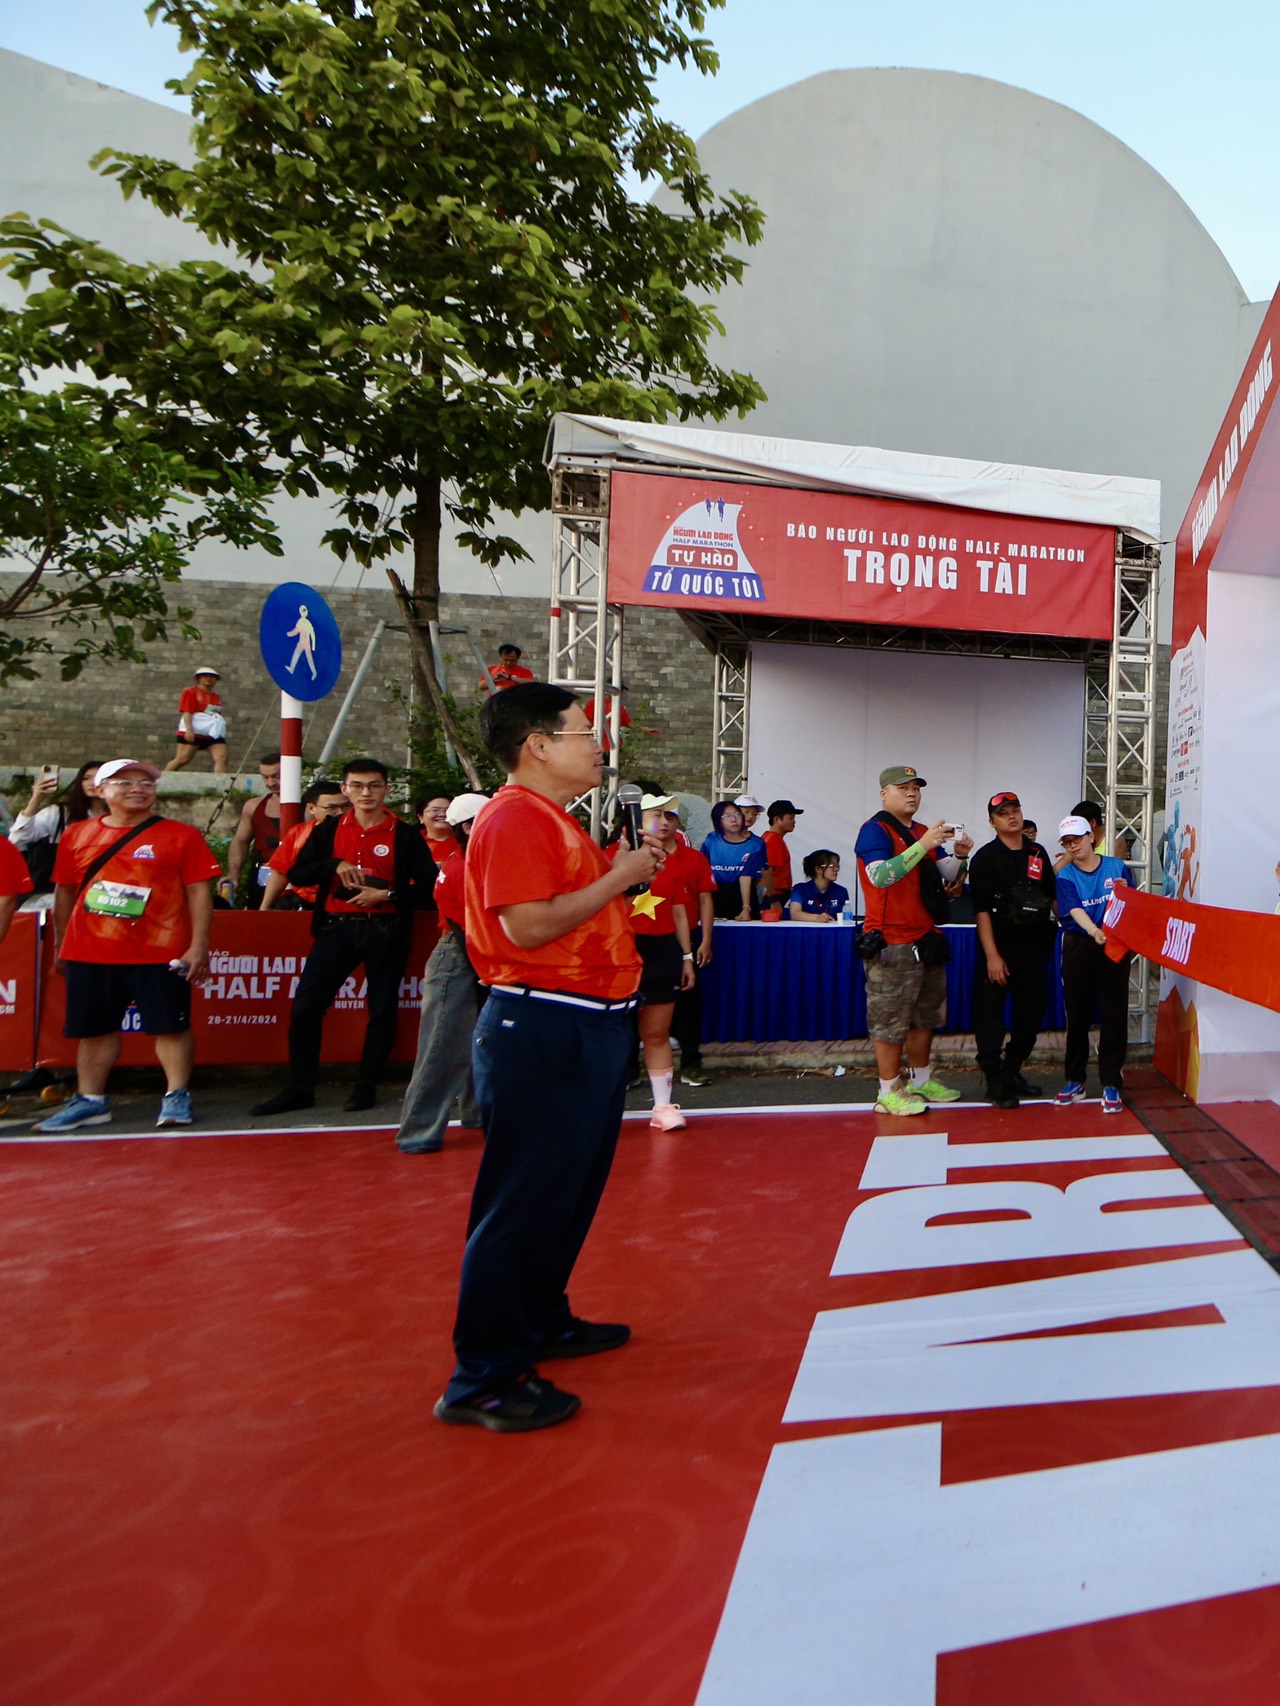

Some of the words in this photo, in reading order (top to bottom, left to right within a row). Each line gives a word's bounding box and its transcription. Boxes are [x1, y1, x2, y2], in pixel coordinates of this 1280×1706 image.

[1218, 424, 1240, 502] LAO
[672, 537, 691, 545] HALF
[691, 539, 734, 549] MARATHON
[786, 522, 817, 539] BÁO
[826, 526, 874, 544] NGƯỜI
[882, 532, 910, 547] LAO
[917, 535, 957, 552] ĐỘNG
[965, 539, 1000, 555] HALF
[1008, 543, 1085, 563] MARATHON
[671, 548, 696, 566] TỰ
[701, 548, 734, 567] HÀO
[843, 548, 958, 593] TRỌNG
[976, 556, 1027, 596] TÀI
[680, 571, 724, 596] QUỐC
[732, 576, 760, 599] TÔI
[1161, 916, 1196, 965] START
[263, 956, 297, 974] LAO
[204, 976, 281, 999] HALF
[207, 1014, 278, 1026] 20-21/4/2024
